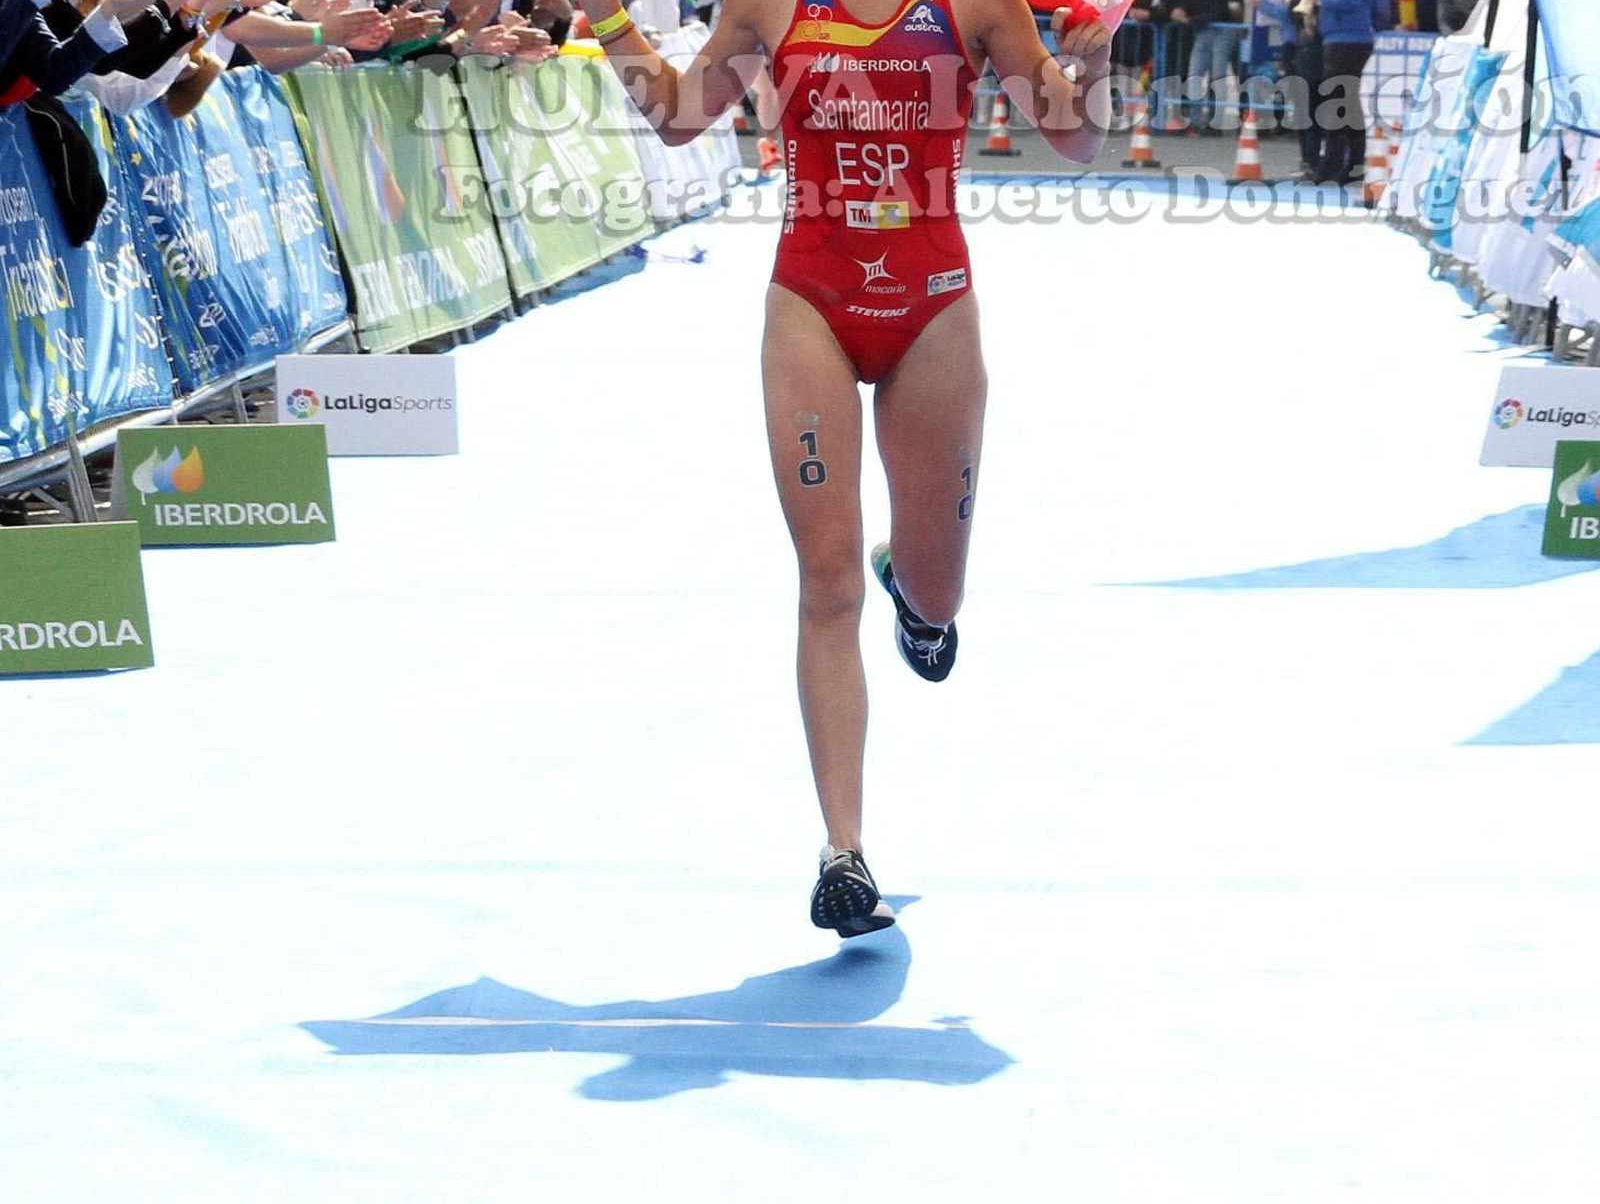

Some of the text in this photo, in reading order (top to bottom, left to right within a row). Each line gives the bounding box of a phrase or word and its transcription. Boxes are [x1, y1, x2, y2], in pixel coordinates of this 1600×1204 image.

[905, 22, 944, 34] austral
[843, 58, 932, 74] IBERDROLA
[808, 88, 930, 132] Santamaría
[835, 141, 910, 187] ESP
[784, 139, 798, 234] SHIMANO
[850, 207, 872, 224] TM
[846, 304, 911, 318] STEVENS
[324, 393, 453, 414] LaLigaSports
[154, 501, 327, 526] IBERDROLA
